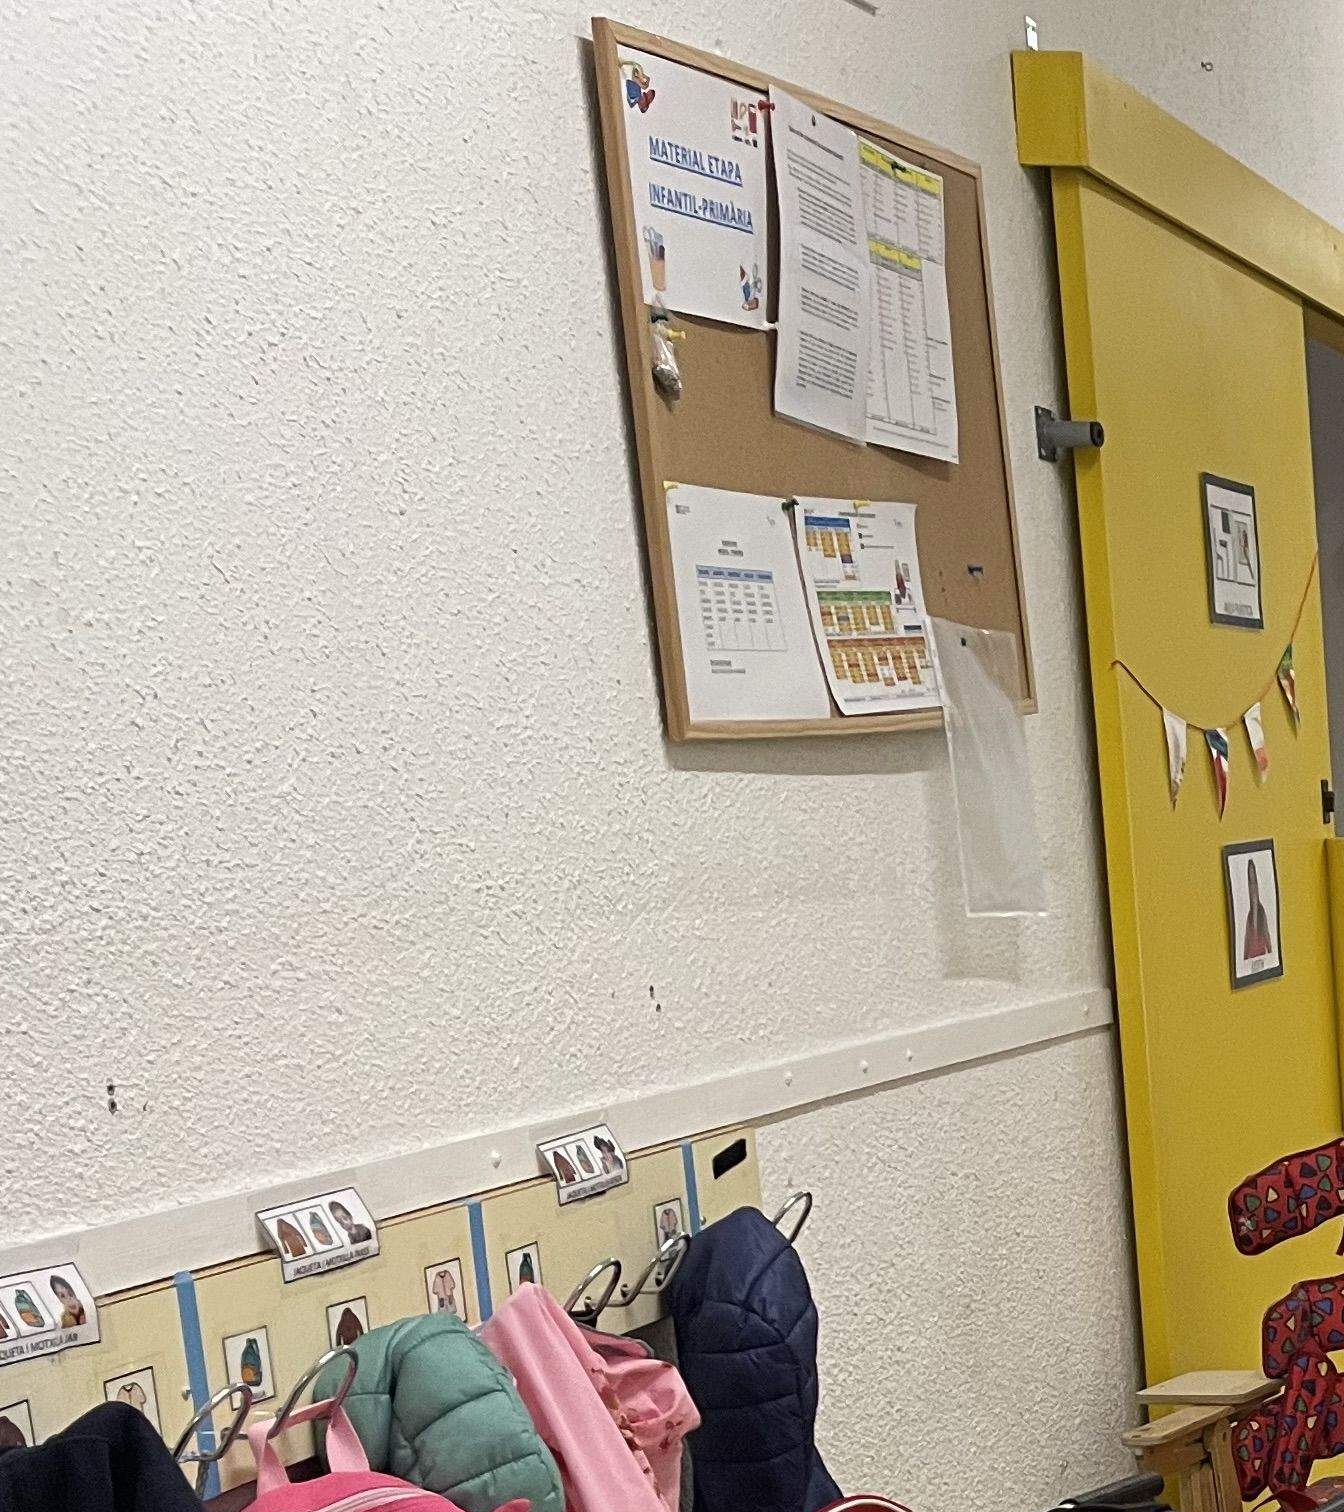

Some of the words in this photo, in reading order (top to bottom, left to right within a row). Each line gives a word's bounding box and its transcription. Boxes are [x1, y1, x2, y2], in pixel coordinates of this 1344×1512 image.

[648, 136, 705, 172] MATERIAL
[707, 154, 742, 183] ETAPA
[648, 182, 753, 229] INFANTIL-PRIMÀRIA
